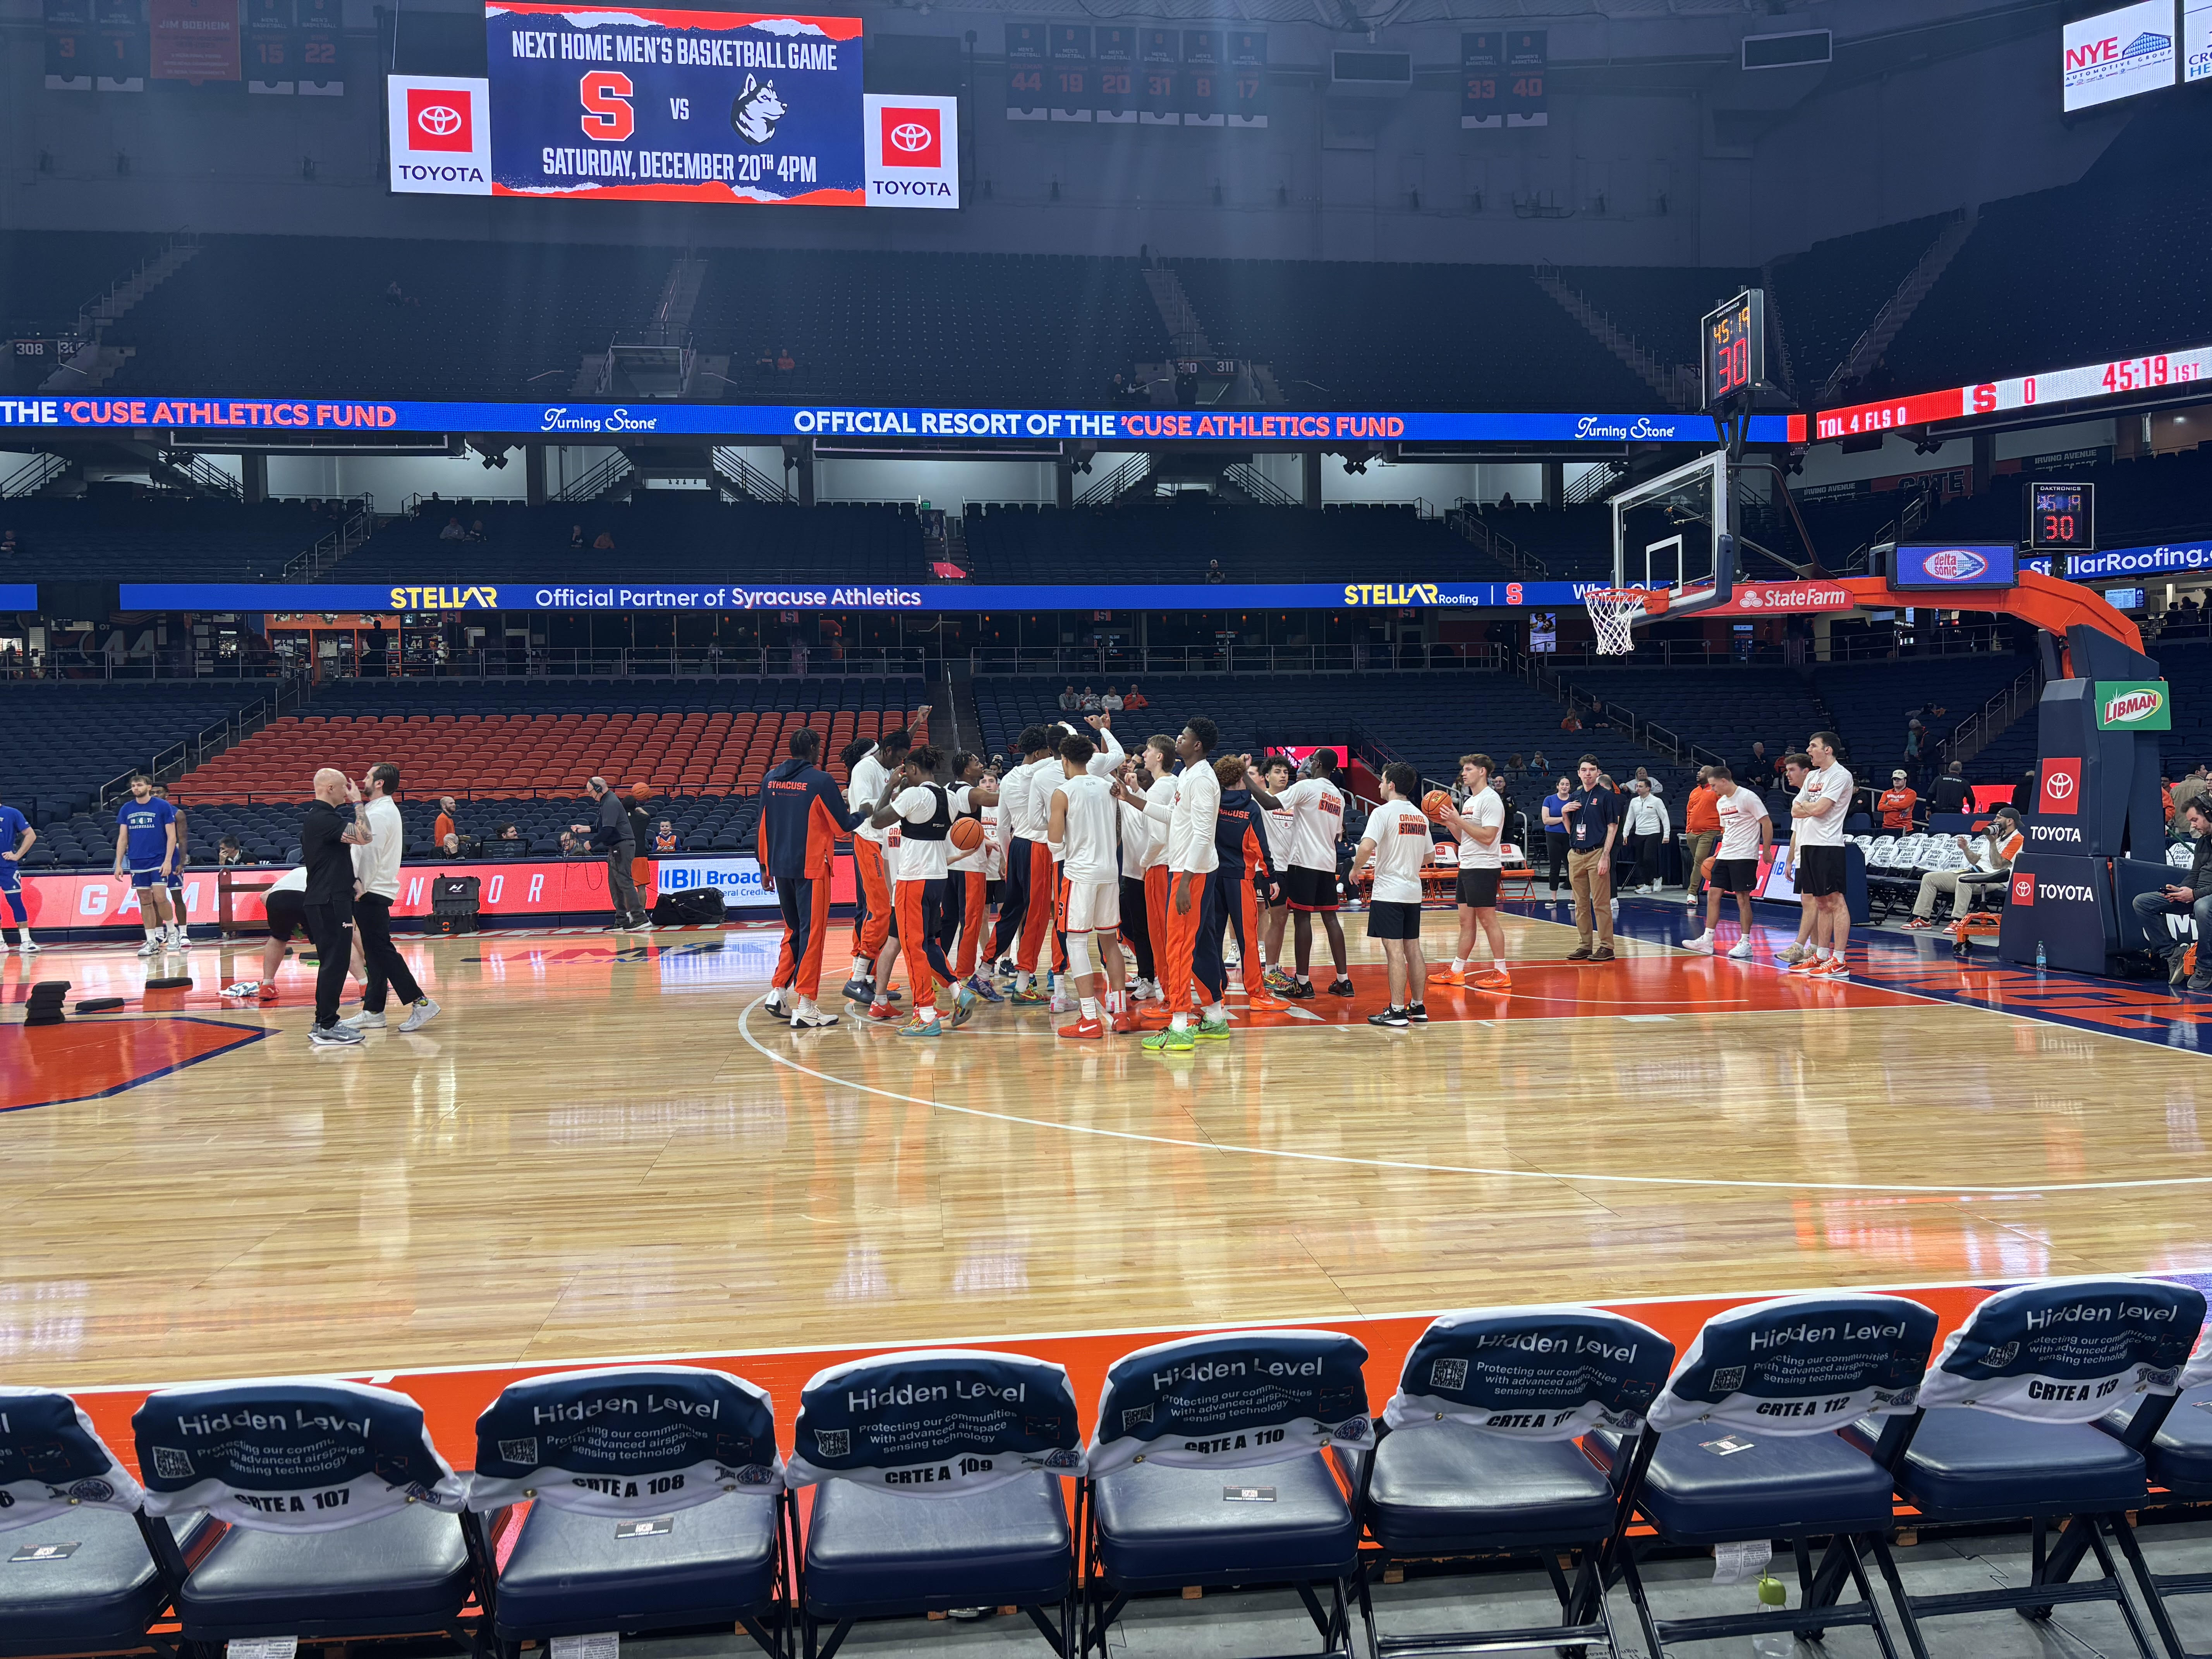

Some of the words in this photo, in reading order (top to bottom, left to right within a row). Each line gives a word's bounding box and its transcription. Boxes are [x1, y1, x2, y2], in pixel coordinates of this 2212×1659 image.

[159, 21, 179, 29] JIM
[182, 21, 230, 30] BOEHEIM
[60, 38, 75, 58] 3
[114, 40, 124, 59] 1
[258, 44, 283, 64] 15
[305, 43, 335, 63] 22
[512, 31, 557, 58] NEXT
[561, 33, 613, 61] HOME
[617, 35, 672, 64] MEN'S
[677, 38, 785, 68] BASKETBALL
[788, 43, 837, 70] GAME
[2066, 37, 2118, 70] NYE
[2066, 60, 2130, 81] AUTOMOTIVE
[2138, 50, 2171, 62] GROUP
[1012, 73, 1042, 91] 44
[1060, 74, 1082, 92] 19
[1103, 75, 1130, 93] 20
[1149, 77, 1170, 96] 31
[1197, 78, 1210, 97] 8
[1237, 80, 1259, 98] 17
[1468, 80, 1495, 99] 33
[1513, 78, 1542, 97] 40
[580, 70, 634, 141] S
[670, 98, 689, 120] VS
[399, 165, 483, 182] TOYOTA
[543, 148, 636, 180] SATURDAY,
[639, 151, 734, 180] DECEMBER
[738, 154, 773, 181] 20TH
[777, 156, 816, 182] 4PM
[873, 180, 951, 197] TOYOTA
[1717, 301, 1740, 318] DAKTRONICS
[1714, 306, 1750, 344] 45:19
[16, 343, 43, 355] 308
[1217, 361, 1233, 372] 311
[1719, 338, 1747, 393] 30
[2102, 356, 2167, 392] 45:19
[2174, 362, 2200, 382] 1ST
[1973, 383, 1997, 414] S
[2024, 378, 2036, 404] 0
[0, 401, 58, 423] THE
[63, 402, 147, 424] 'CUSE
[153, 402, 309, 426] ATHLETICS
[316, 404, 397, 427] FUND
[541, 408, 601, 432] Turning
[605, 409, 657, 431] Stone
[794, 410, 916, 433] OFFICIAL
[922, 412, 1021, 435] RESORT
[1026, 414, 1061, 435] OF
[1063, 415, 1115, 436] THE
[1120, 416, 1192, 436] 'CUSE
[1197, 416, 1330, 437] ATHLETICS
[1336, 417, 1405, 437] FUND
[1819, 417, 1844, 438] TOL
[1850, 414, 1859, 433] 4
[1865, 409, 1891, 430] FLS
[1897, 407, 1906, 426] 0
[1575, 417, 1626, 439] Turning
[1630, 417, 1675, 439] Stone
[2034, 455, 2062, 464] IRVING
[2064, 449, 2097, 460] AVENUE
[1804, 486, 1826, 496] IRVING
[1828, 483, 1855, 493] AVENUE
[2046, 515, 2074, 540] 30
[1935, 553, 1956, 565] delta
[2030, 547, 2212, 576] StllarRoofing.
[1935, 565, 1957, 576] sonic
[391, 587, 497, 609] STELLAR
[536, 588, 613, 607] Official
[620, 589, 699, 607] Partner
[704, 588, 726, 607] of
[732, 587, 827, 610] Syracuse
[831, 587, 921, 606] Athletics
[1345, 584, 1437, 605] STELLAR
[1439, 593, 1478, 606] Roofing
[1506, 582, 1523, 605] S
[100, 630, 154, 665] 44
[410, 640, 422, 649] 44
[2104, 693, 2157, 725] LIBMAN
[768, 781, 808, 791] SYRACUSE
[1399, 814, 1426, 823] ORANGE
[2030, 826, 2081, 842] TOYOTA
[2039, 884, 2094, 902] TOYOTA
[2027, 1304, 2111, 1331] Hidden
[2117, 1302, 2178, 1322] Level
[1750, 1324, 1835, 1351] Hidden
[1843, 1322, 1906, 1340] Level
[1476, 1333, 1567, 1353] Hidden
[1575, 1335, 1637, 1364] Level
[1153, 1361, 1246, 1391] Hidden
[1254, 1357, 1322, 1376] Level
[1477, 1361, 1534, 1377] Protecting
[1557, 1364, 1617, 1384] communities
[1485, 1374, 1509, 1384] with
[1511, 1375, 1563, 1386] advanced
[848, 1384, 947, 1412] Hidden
[956, 1380, 1025, 1403] Level
[1494, 1386, 1535, 1396] sensing
[2028, 1380, 2076, 1401] CRTE
[2078, 1385, 2092, 1401] A
[2096, 1378, 2119, 1398] 113
[533, 1396, 638, 1425] Hidden
[647, 1394, 719, 1420] Level
[1756, 1402, 1803, 1417] CRTE
[1803, 1401, 1817, 1416] A
[1824, 1396, 1851, 1413] 112
[178, 1409, 286, 1435] Hidden
[295, 1409, 370, 1438] Level
[859, 1421, 919, 1434] Protecting
[923, 1419, 942, 1427] our
[945, 1409, 1017, 1424] communities
[1486, 1414, 1531, 1428] CRTE
[1531, 1413, 1546, 1427] A
[870, 1434, 896, 1444] with
[900, 1423, 955, 1442] advanced
[959, 1421, 1007, 1433] airspace
[884, 1440, 929, 1454] sensing
[932, 1432, 995, 1447] technology
[1185, 1436, 1231, 1454] CRTE
[1235, 1434, 1247, 1448] A
[1255, 1429, 1285, 1445] 110
[885, 1468, 934, 1484] CRTE
[938, 1466, 951, 1481] A
[958, 1457, 993, 1476] 109
[624, 1481, 639, 1498] A
[647, 1475, 685, 1495] 108
[290, 1496, 306, 1511] A
[312, 1488, 349, 1508] 107
